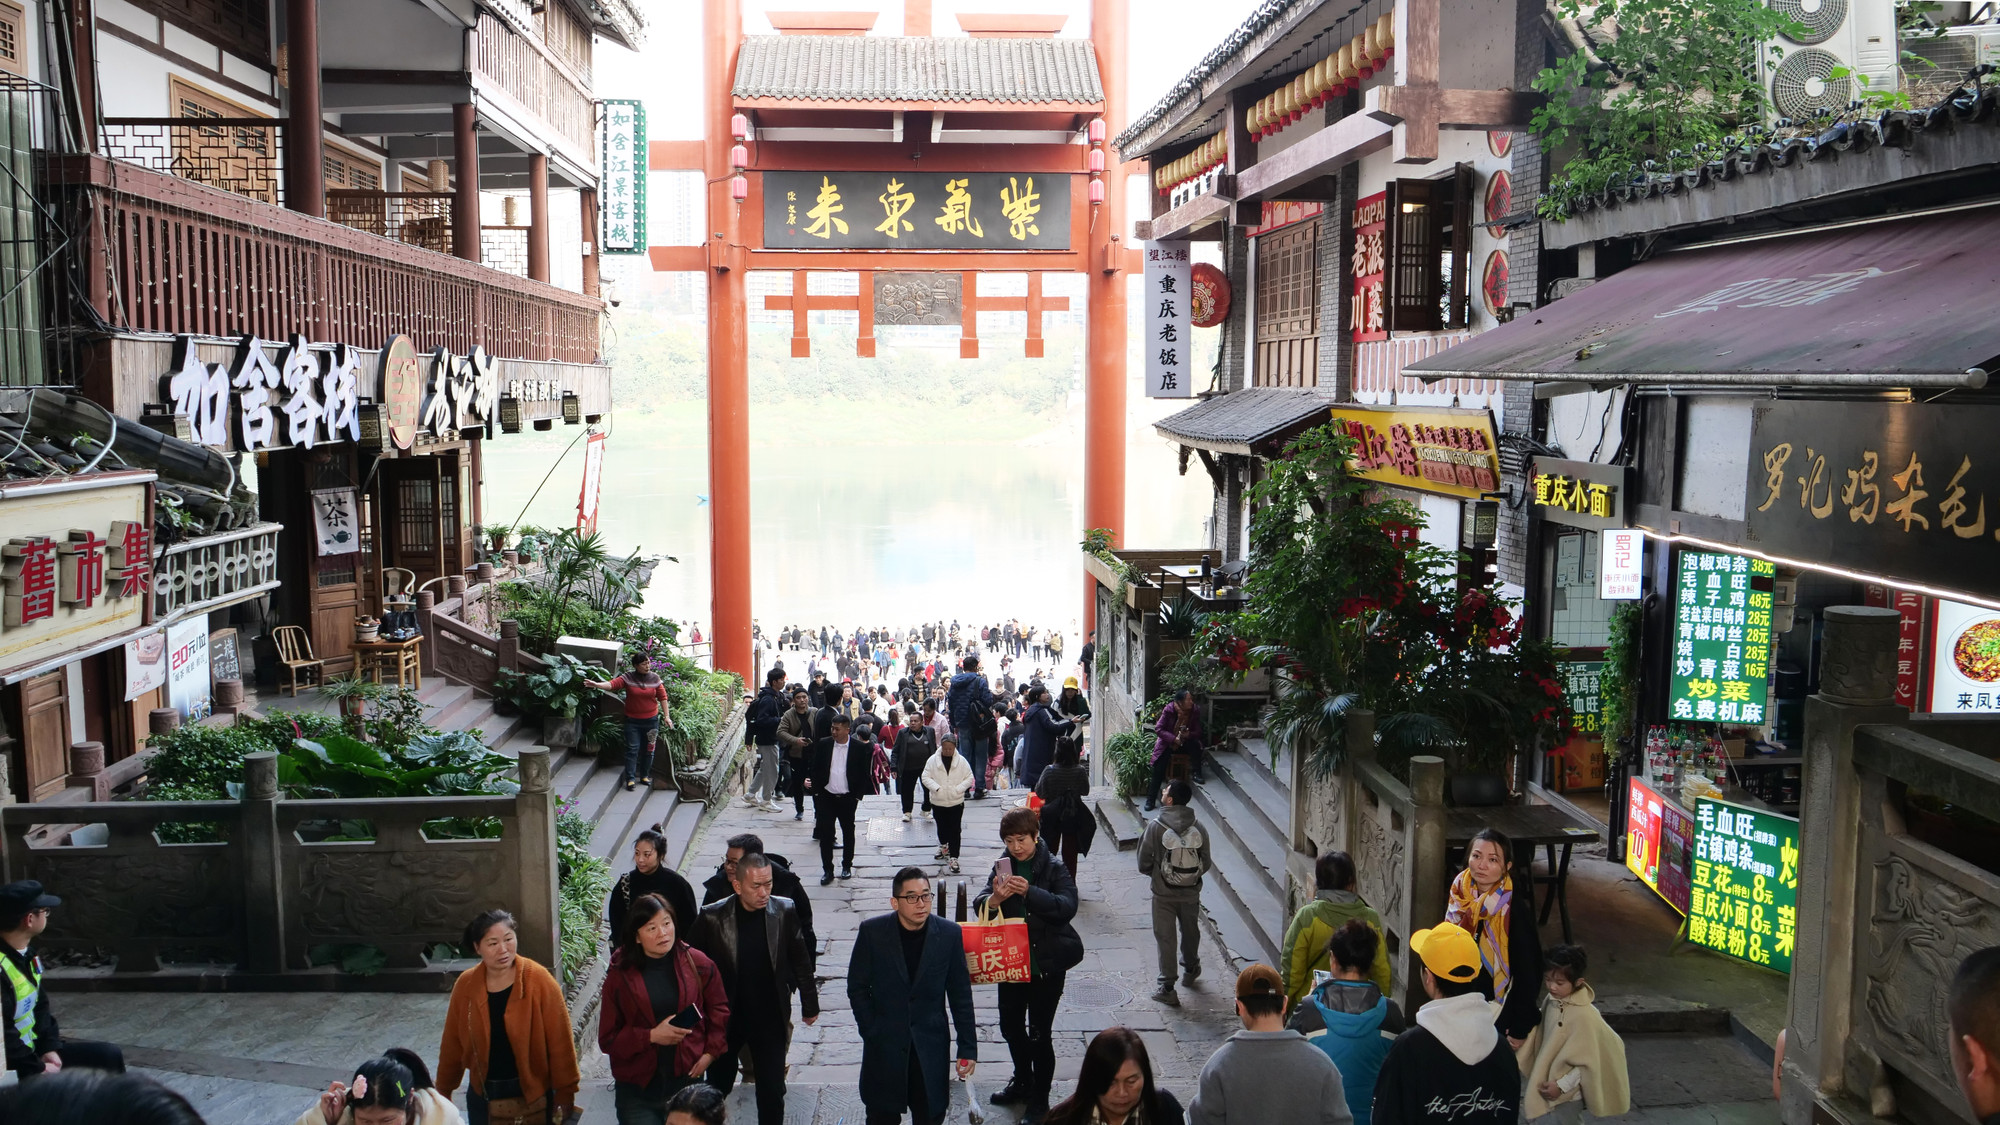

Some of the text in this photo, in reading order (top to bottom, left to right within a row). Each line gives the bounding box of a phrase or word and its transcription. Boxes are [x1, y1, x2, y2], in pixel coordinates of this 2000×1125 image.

[610, 110, 631, 243] 如舍江景客栈
[1149, 249, 1188, 262] 望江楼
[1351, 229, 1385, 278] 老派
[1349, 280, 1384, 334] 川菜
[1157, 274, 1179, 391] 重庆老饭店
[1534, 473, 1608, 518] 重庆小面
[1757, 442, 2000, 539] 罗记鸡杂毛
[322, 498, 349, 527] 茶
[1615, 534, 1631, 568] 罗记
[1683, 553, 1774, 575] 泡椒鸡杂 38元
[19, 522, 150, 626] 舊市集
[1604, 573, 1640, 583] 重庆小面
[1682, 570, 1747, 591] 毛血旺
[1680, 588, 1771, 609] 辣子鸡 48元
[1680, 605, 1770, 627] 老盐菜回锅肉 28元
[1679, 622, 1769, 644] 青椒肉丝 28元
[1898, 592, 1918, 698] 三十年匠心
[171, 632, 207, 672] 20元/位
[1677, 640, 1768, 661] 烧白 28元
[1676, 657, 1766, 680] 炒青菜 16元
[1687, 678, 1752, 701] 炒菜
[1673, 697, 1763, 723] 免费机麻
[1632, 786, 1644, 808] 鲜榨
[1631, 804, 1648, 829] 西瓜汁
[1664, 807, 1694, 843] 鲜榨果汁
[1632, 828, 1646, 861] 10
[1691, 887, 1750, 930] 重庆小面
[1750, 904, 1772, 936] 8元
[1688, 914, 1770, 965] 酸辣粉 8元
[965, 948, 1005, 976] 重庆
[973, 965, 1029, 983] 欢迎你!
